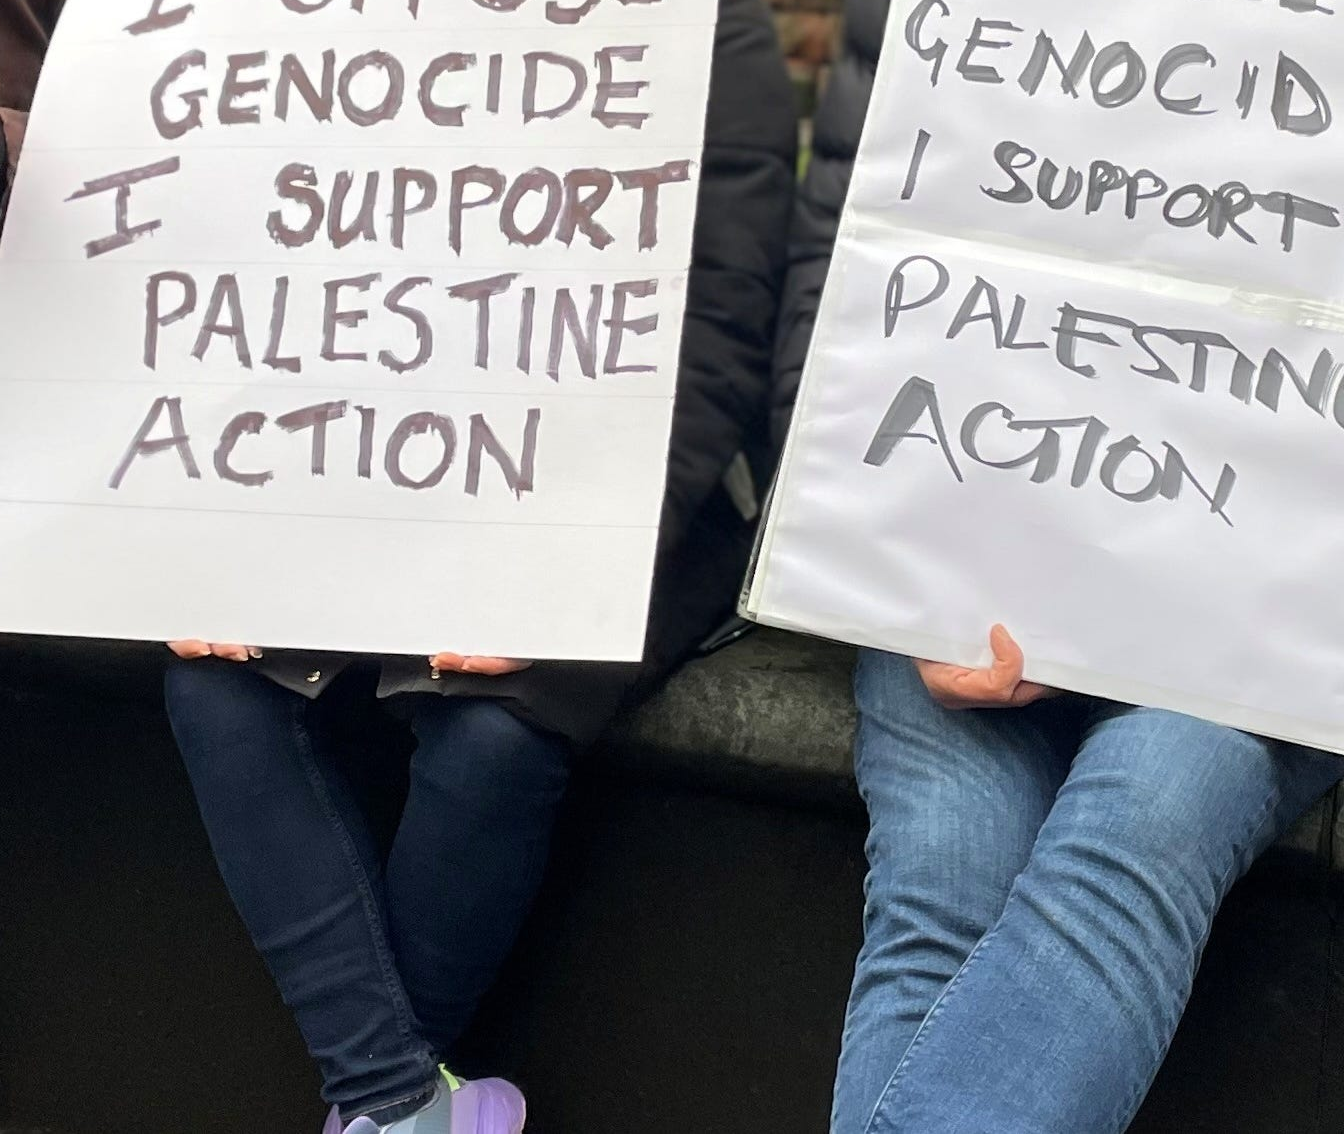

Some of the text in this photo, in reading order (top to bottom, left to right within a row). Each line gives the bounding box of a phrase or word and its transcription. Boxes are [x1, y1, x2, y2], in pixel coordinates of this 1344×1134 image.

[149, 44, 652, 141] GENOCIDE
[63, 154, 696, 259] I SUPPORT
[979, 138, 1342, 253] SUPPORT
[142, 270, 659, 384] PALESTINE
[106, 395, 542, 501] ACTION
[861, 374, 1239, 527] ACTION
